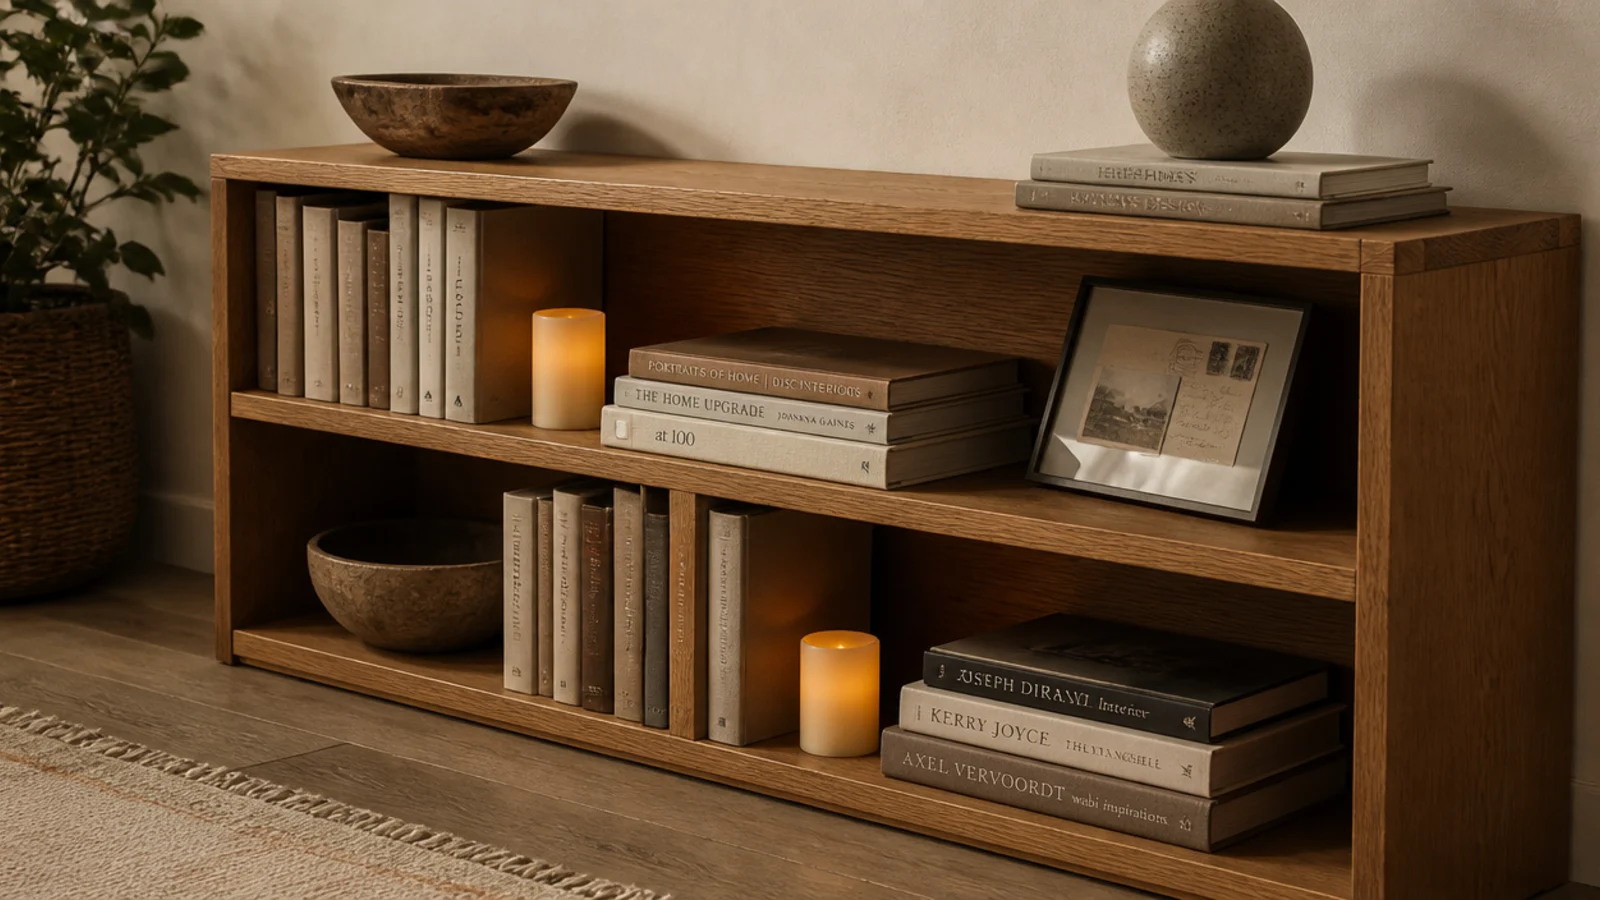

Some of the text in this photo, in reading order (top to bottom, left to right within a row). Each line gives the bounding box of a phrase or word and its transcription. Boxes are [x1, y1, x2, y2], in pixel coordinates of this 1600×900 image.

[709, 368, 725, 379] OF
[727, 369, 760, 385] HOME
[636, 388, 659, 404] THE
[662, 392, 700, 409] HOME
[704, 397, 765, 419] UPGRADE
[655, 429, 695, 446] at 100
[930, 707, 988, 732] KERRY
[991, 721, 1051, 748] JOYCE
[902, 751, 949, 775] AXEL
[954, 761, 1065, 801] VERVOORDT
[1071, 793, 1099, 809] wabi
